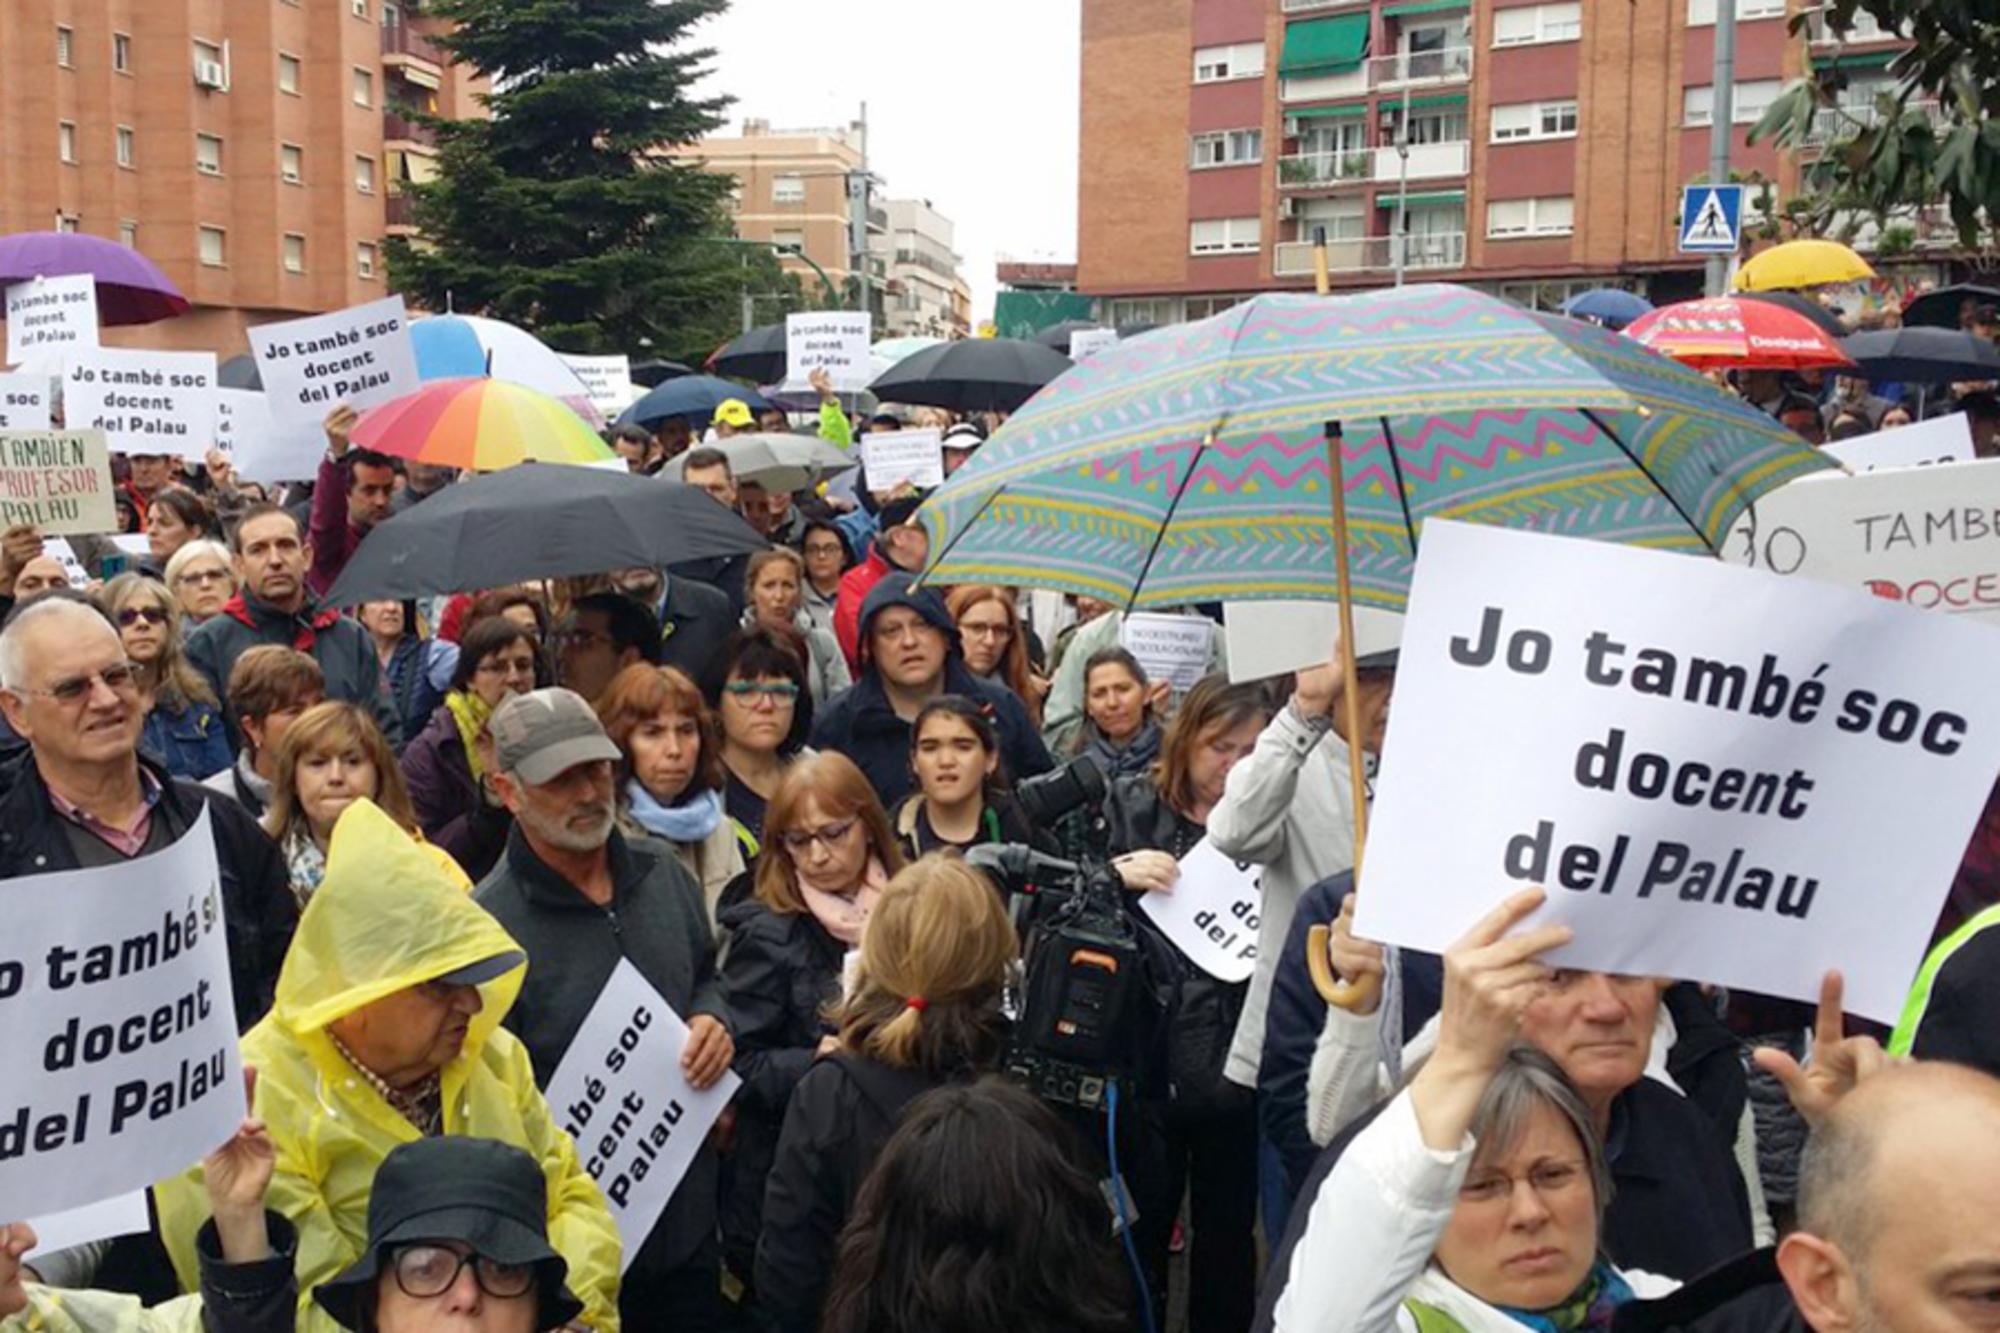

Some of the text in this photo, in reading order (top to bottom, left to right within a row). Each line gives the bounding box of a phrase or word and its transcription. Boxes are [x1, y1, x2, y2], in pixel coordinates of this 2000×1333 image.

[62, 291, 88, 303] soc
[37, 329, 76, 342] Palau
[265, 319, 399, 359] Jo també soc
[72, 366, 206, 388] Jo també soc
[304, 351, 375, 379] docent
[6, 393, 40, 406] soc
[104, 391, 173, 410] docent
[299, 371, 390, 404] del Palau
[93, 416, 187, 435] del Palau
[3, 498, 79, 526] PALAU
[1449, 606, 1968, 757] Jo també soc
[1574, 728, 1815, 820] docent
[1504, 819, 1819, 919] del Palau
[46, 894, 198, 991] també
[1194, 911, 1238, 949] del
[44, 979, 212, 1072] docent
[605, 1006, 652, 1075] soc
[0, 1048, 226, 1160] del Palau
[586, 1069, 645, 1181] cent
[607, 1099, 685, 1209] Palau
